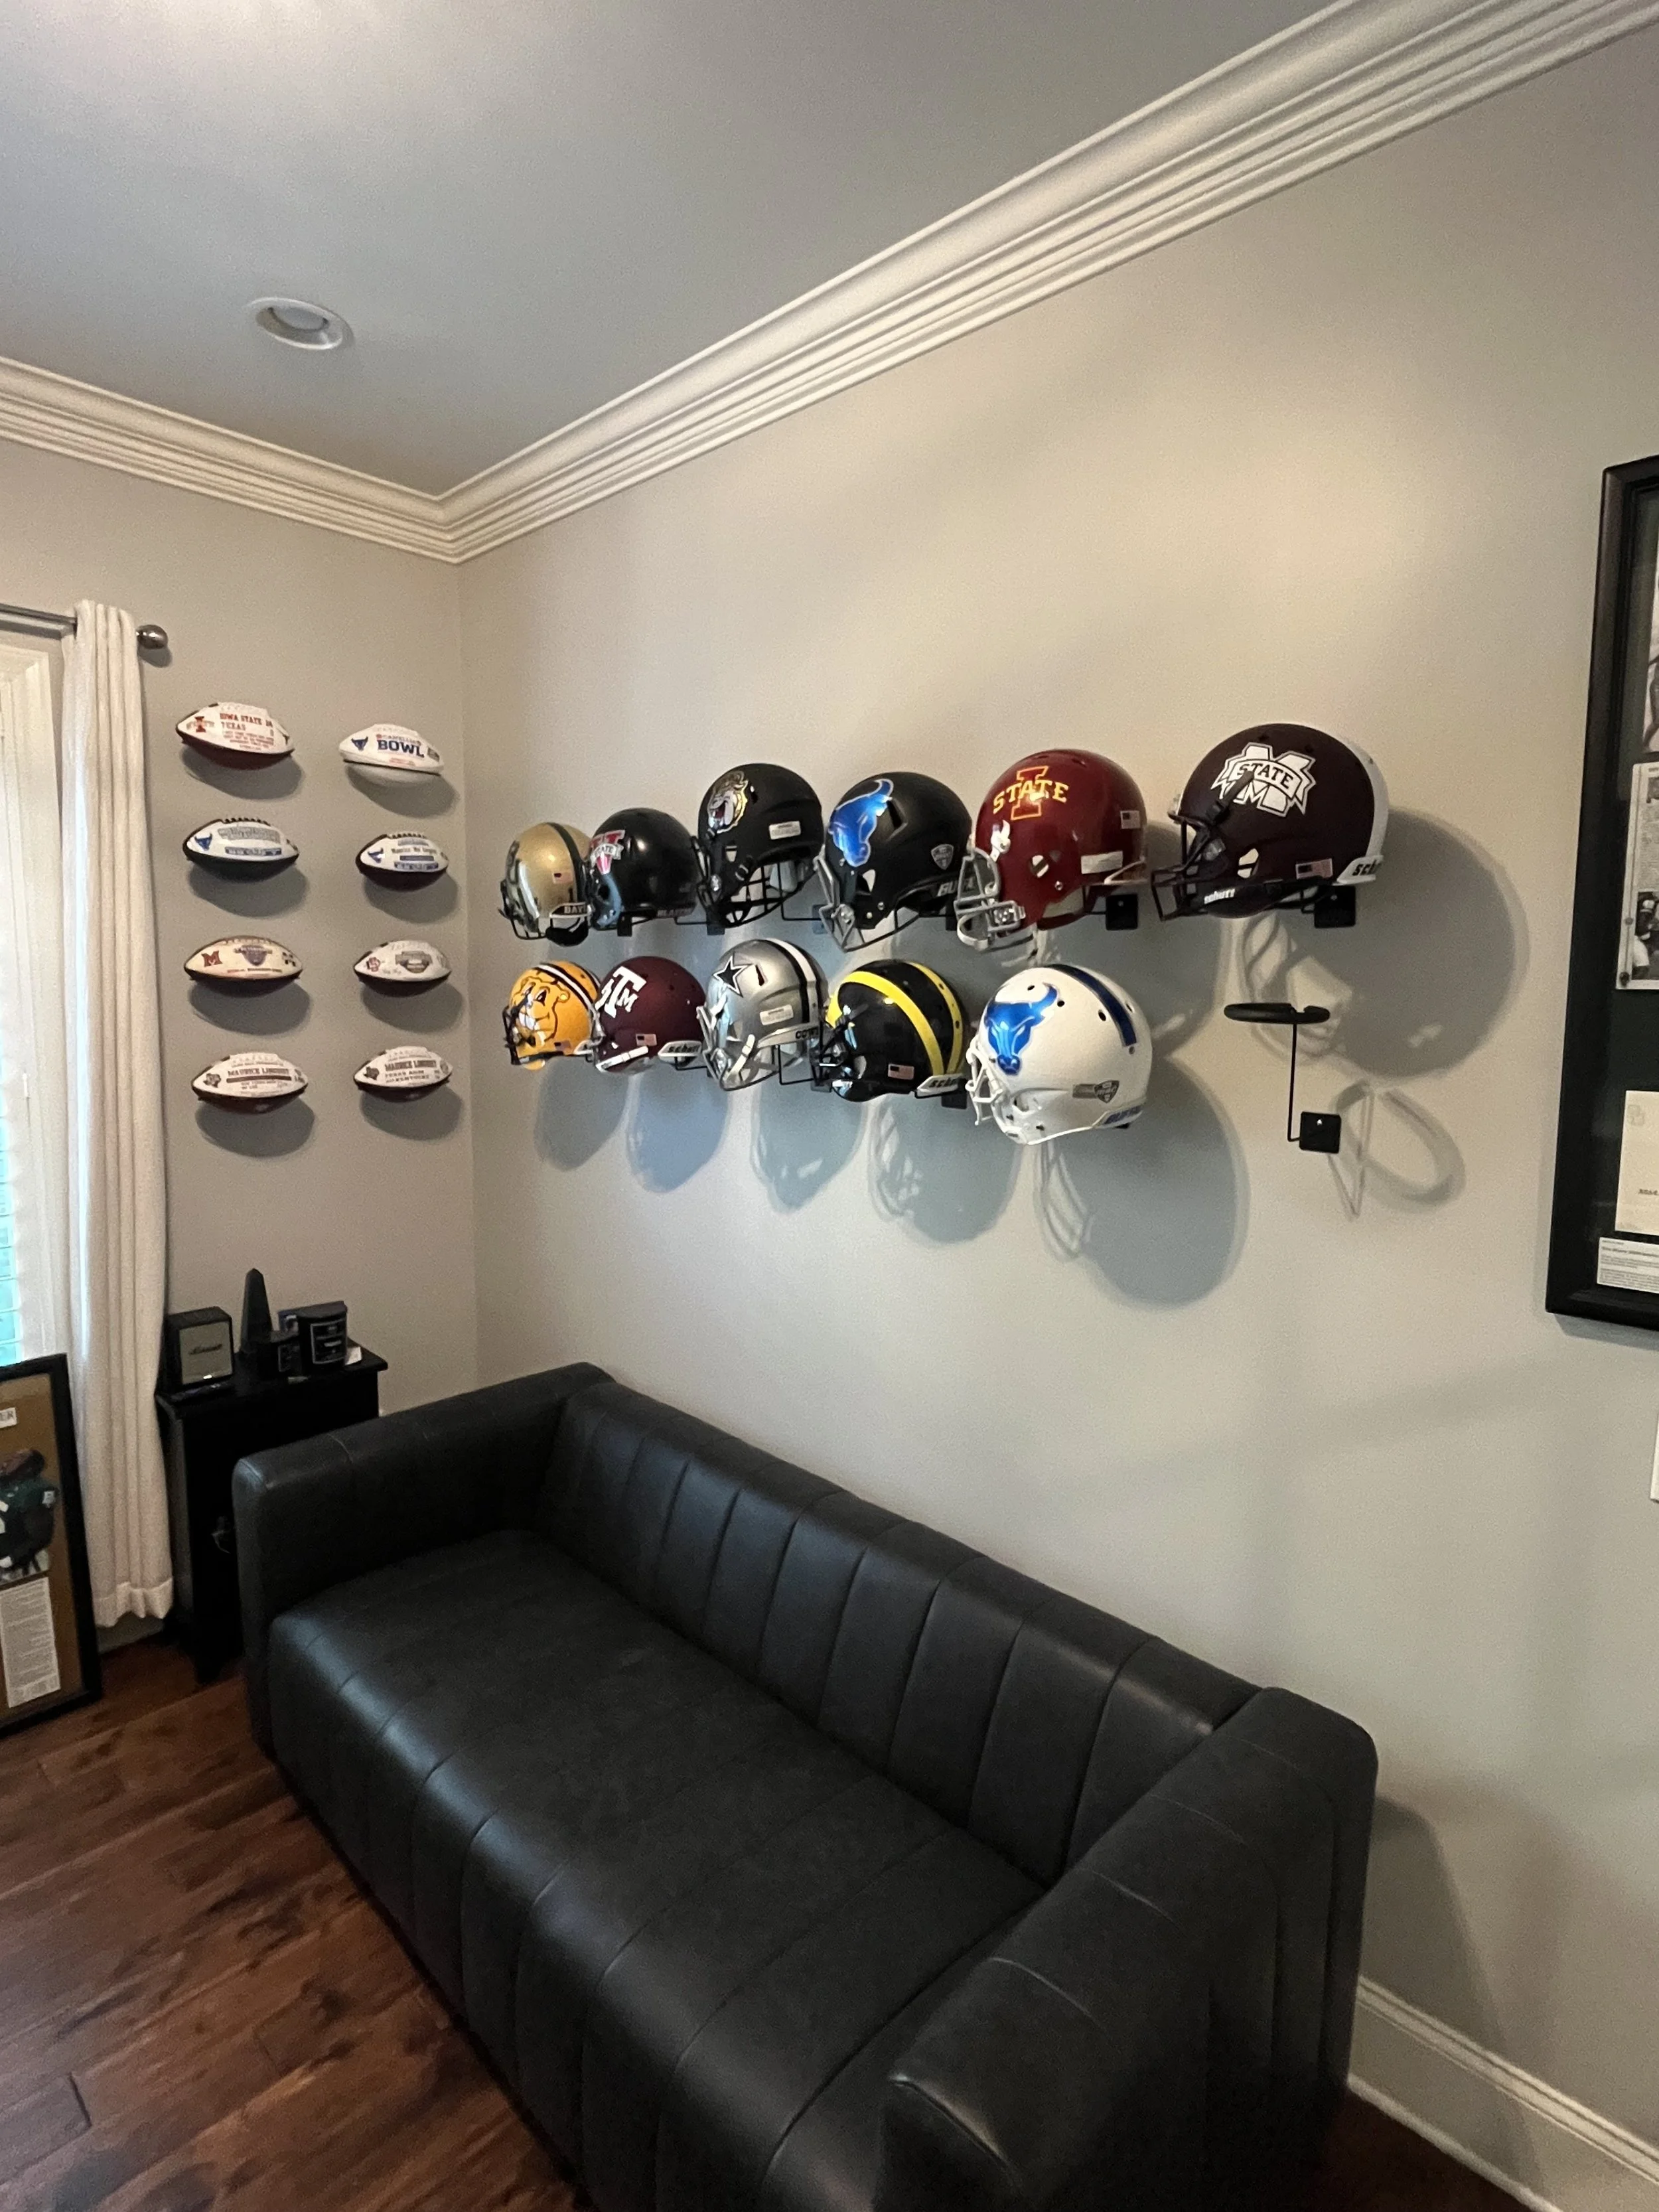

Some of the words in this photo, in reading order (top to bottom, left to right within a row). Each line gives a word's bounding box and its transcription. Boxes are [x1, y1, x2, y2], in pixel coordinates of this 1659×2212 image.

[378, 739, 425, 758] BOWL
[1237, 763, 1294, 790] STATE
[993, 779, 1069, 814] STATE
[201, 950, 223, 967] M
